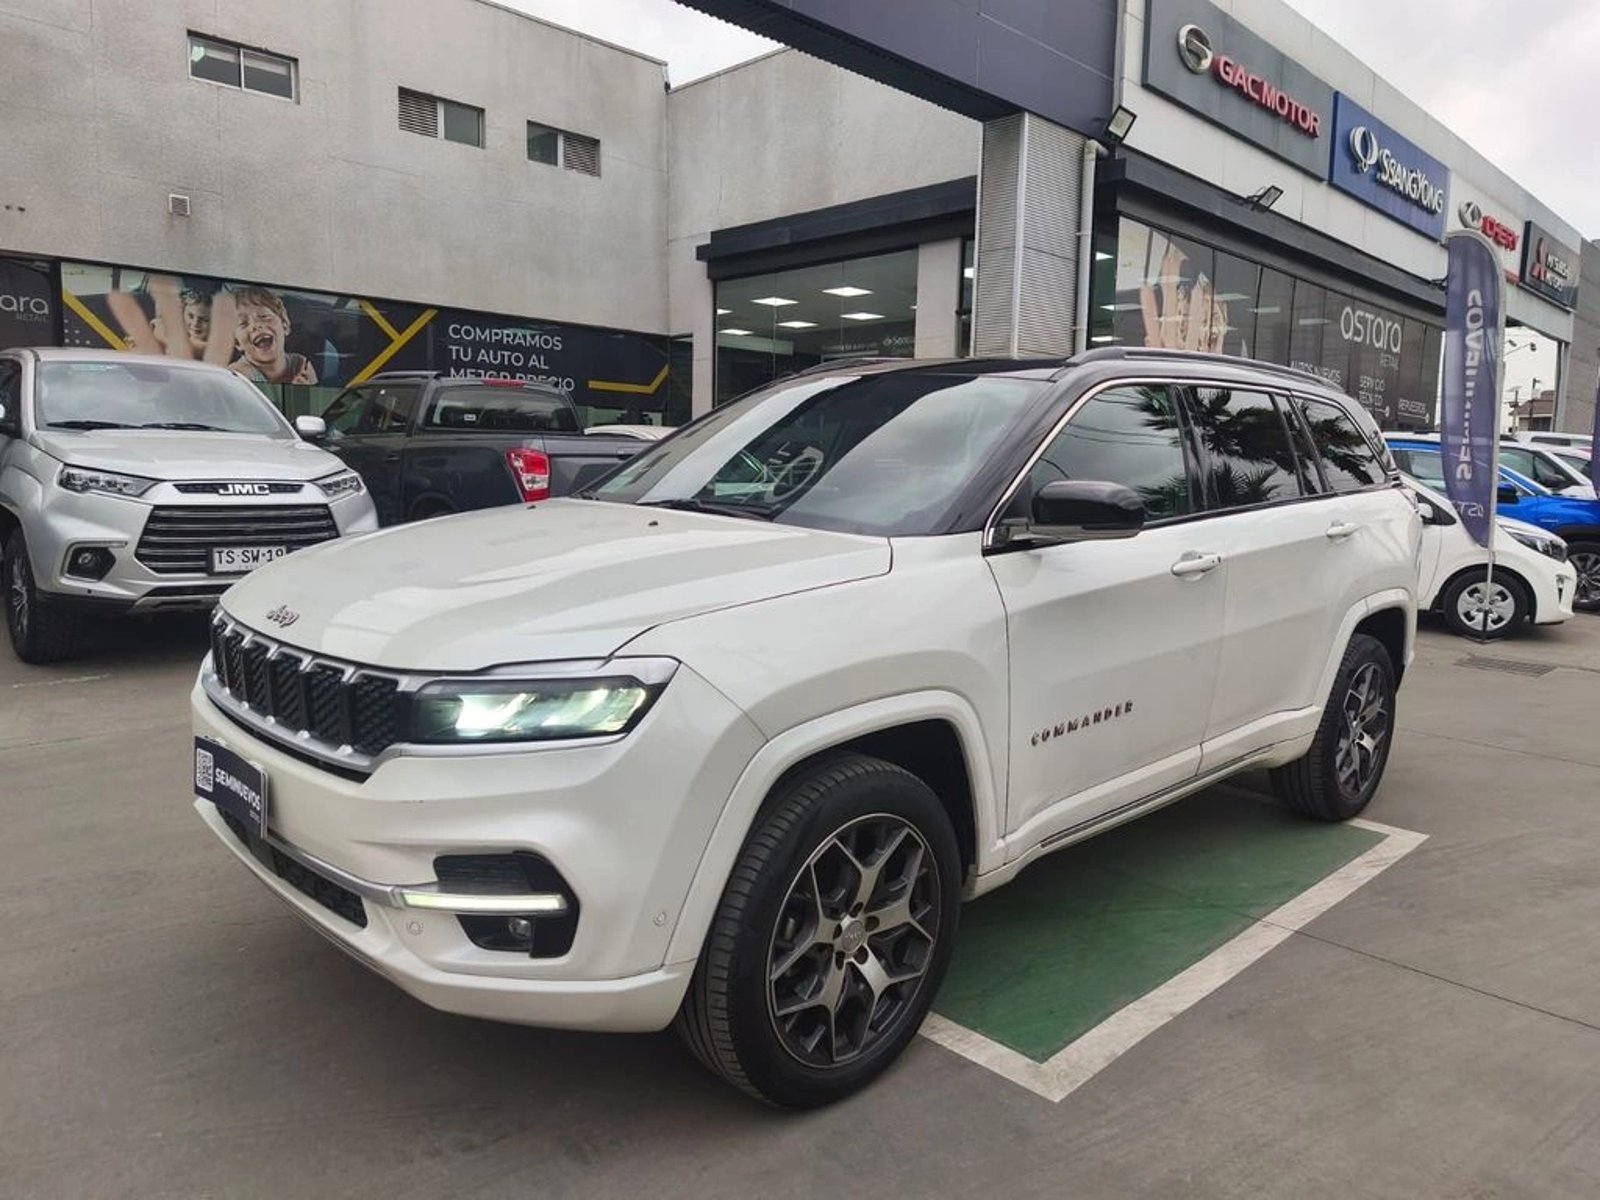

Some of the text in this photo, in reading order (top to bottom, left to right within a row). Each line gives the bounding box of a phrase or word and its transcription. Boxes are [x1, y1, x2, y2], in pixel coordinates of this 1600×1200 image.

[1216, 56, 1320, 138] GAC MOTOR
[448, 323, 563, 351] COMPRAMOS
[447, 345, 550, 370] TU AUTO AL
[218, 483, 270, 496] JMC
[214, 767, 262, 812] SEMINUEVOS
